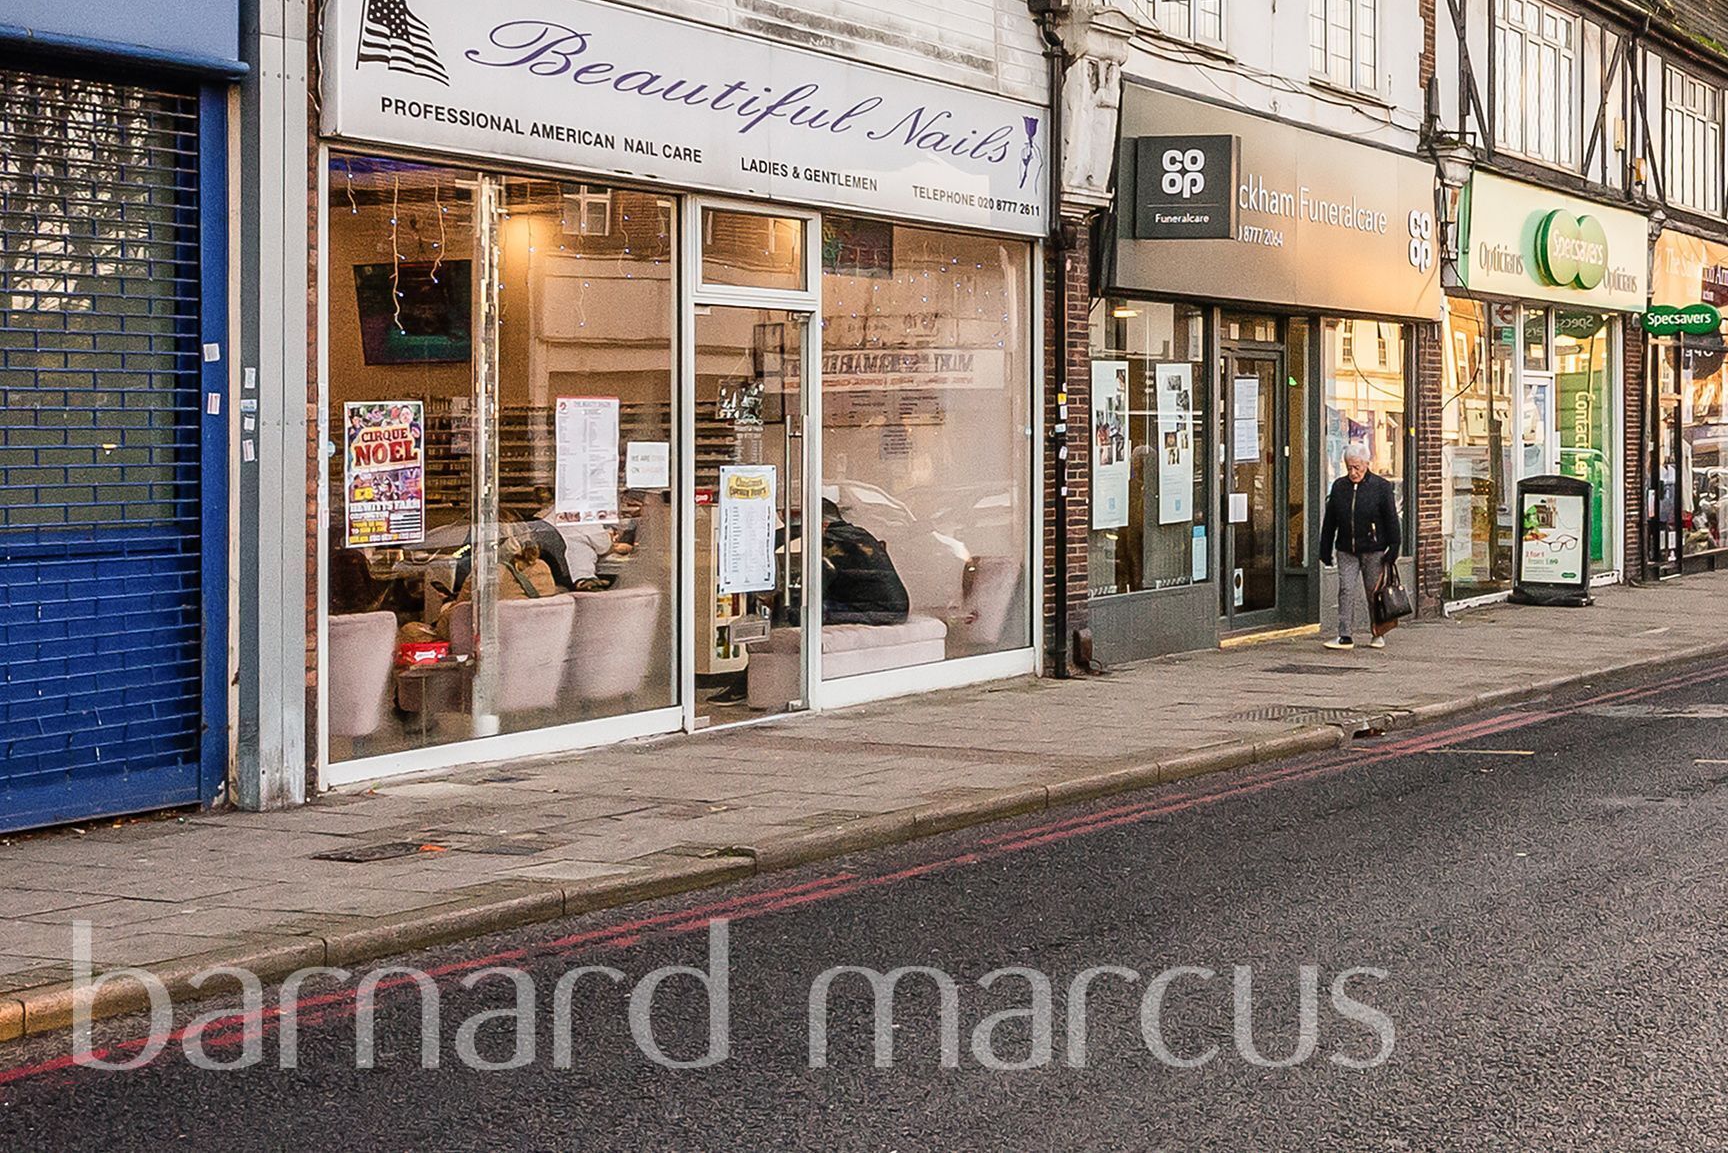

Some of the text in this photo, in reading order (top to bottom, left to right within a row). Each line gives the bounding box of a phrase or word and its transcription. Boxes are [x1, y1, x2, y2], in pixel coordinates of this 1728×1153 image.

[464, 20, 1013, 163] Beautiful Nails
[381, 97, 702, 163] PROFESSIONAL AMERICAN NAIL CARE
[741, 157, 878, 192] LADIES & GENTLEMEN
[912, 185, 1041, 218] TELEPHONE 020 8777 2611
[1155, 213, 1210, 224] Funeralcare
[1300, 186, 1388, 235] Funeralcare
[1244, 226, 1263, 243] 8777
[1264, 229, 1284, 247] 2064
[1553, 231, 1604, 265] Specsavers
[1479, 241, 1638, 296] Opticians Opticians
[1647, 312, 1711, 327] Specsavers
[361, 428, 408, 443] CIRQUE
[1575, 391, 1593, 480] Contact Len
[354, 440, 418, 466] NOEL
